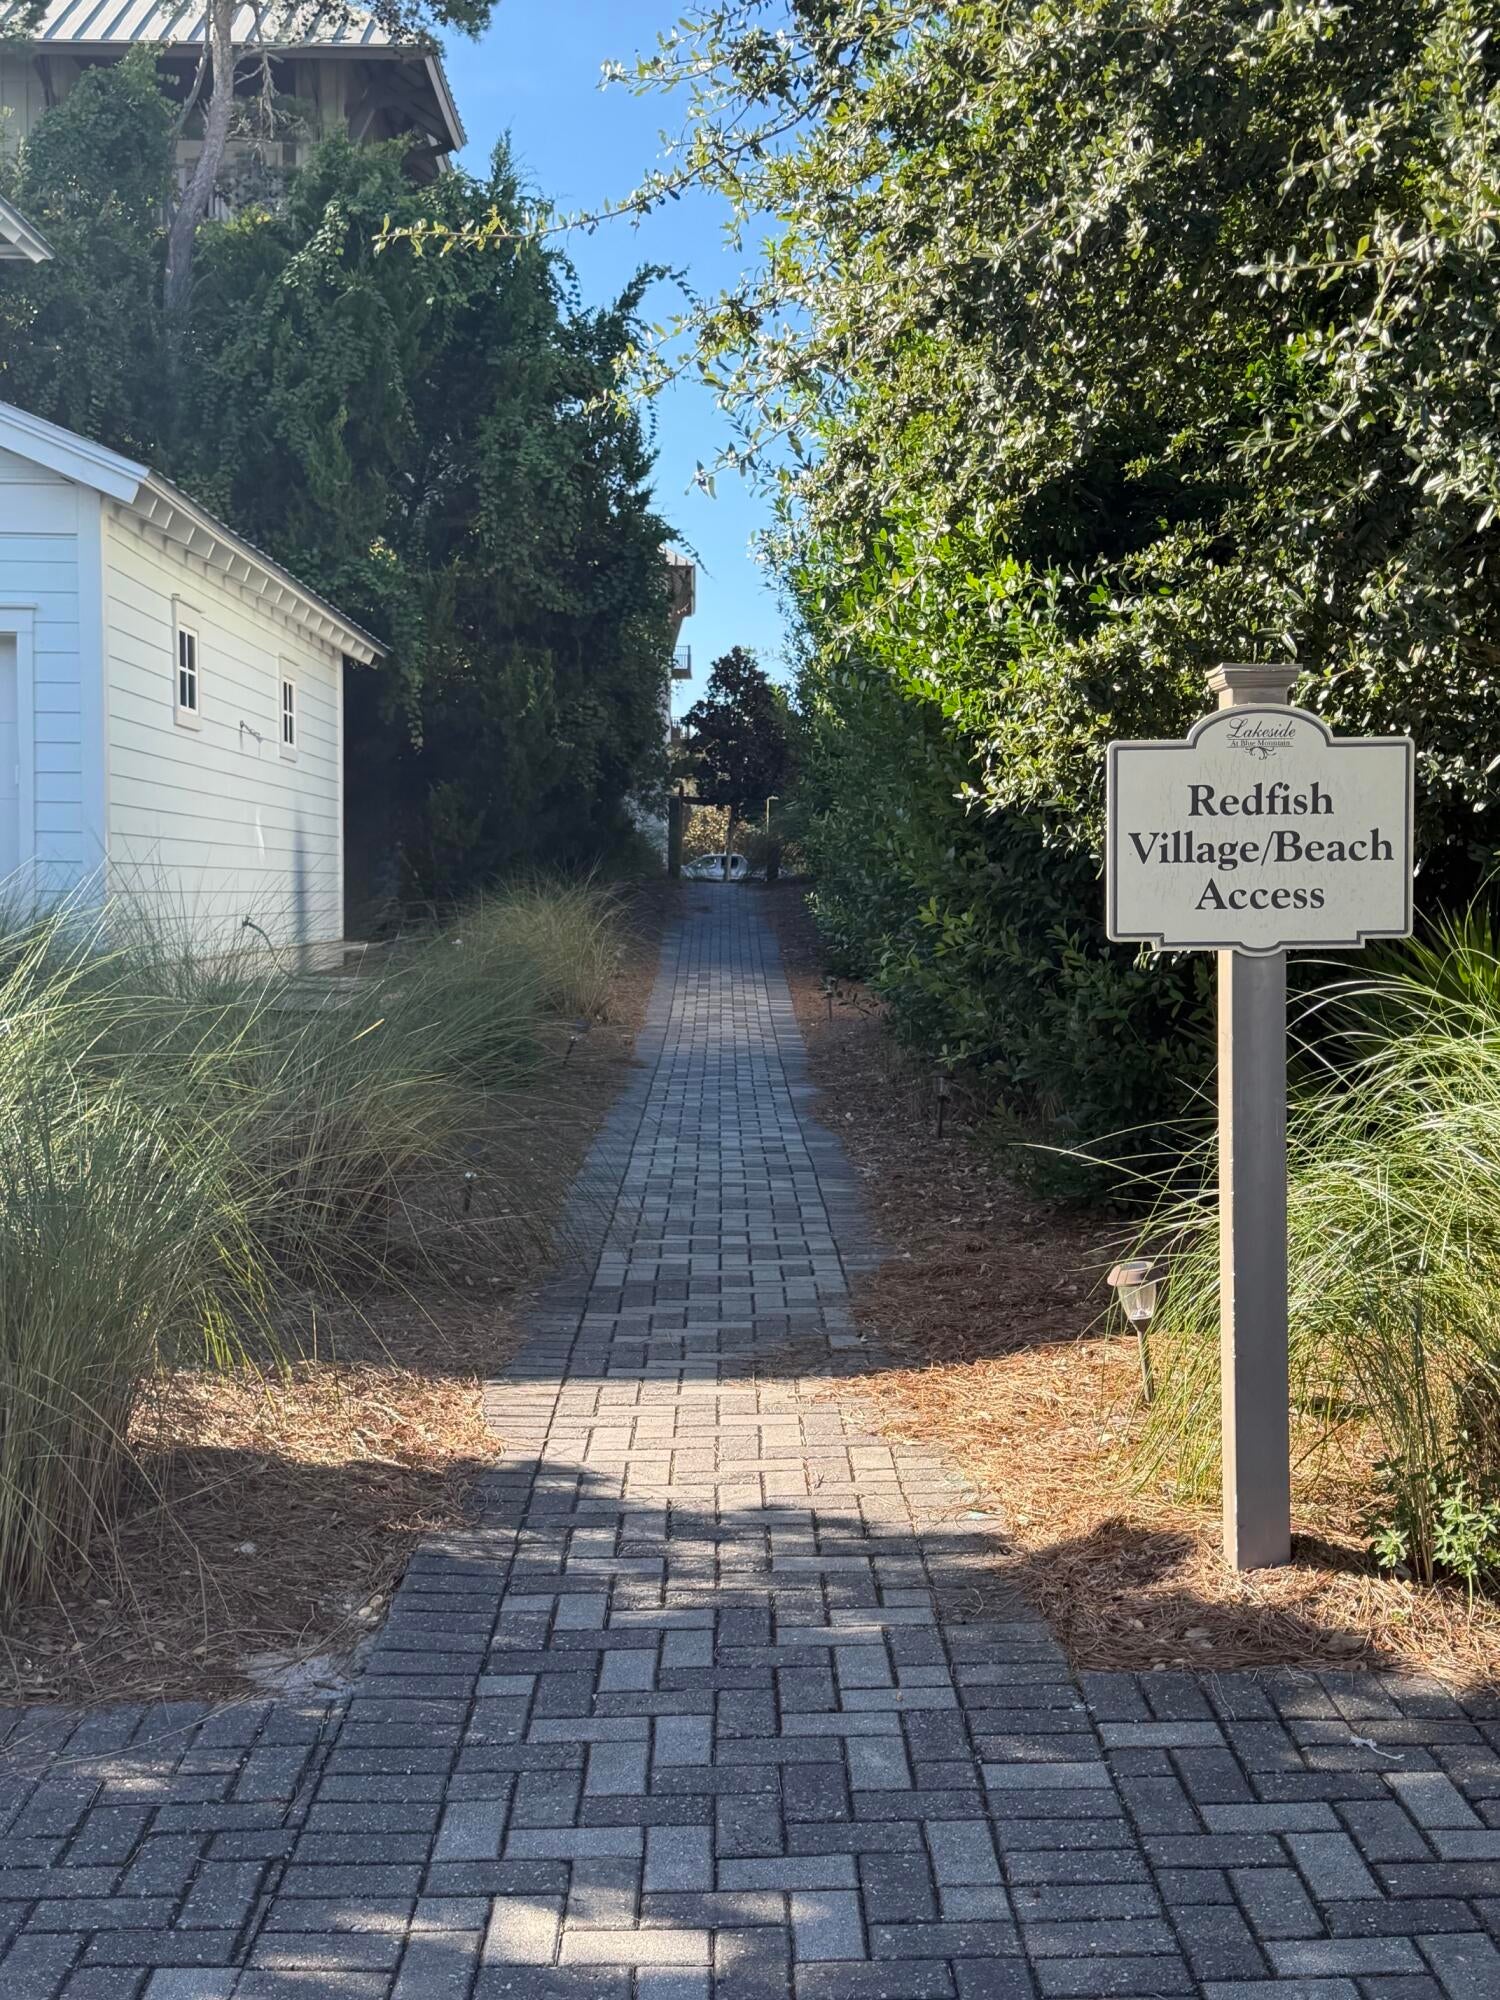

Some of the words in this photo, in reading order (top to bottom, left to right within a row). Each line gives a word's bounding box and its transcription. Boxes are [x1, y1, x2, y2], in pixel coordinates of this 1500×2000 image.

[1226, 717, 1296, 738] Lakeside
[1187, 781, 1334, 816] Redfish
[1128, 827, 1394, 871] Village/Beach
[1195, 877, 1325, 910] Access
